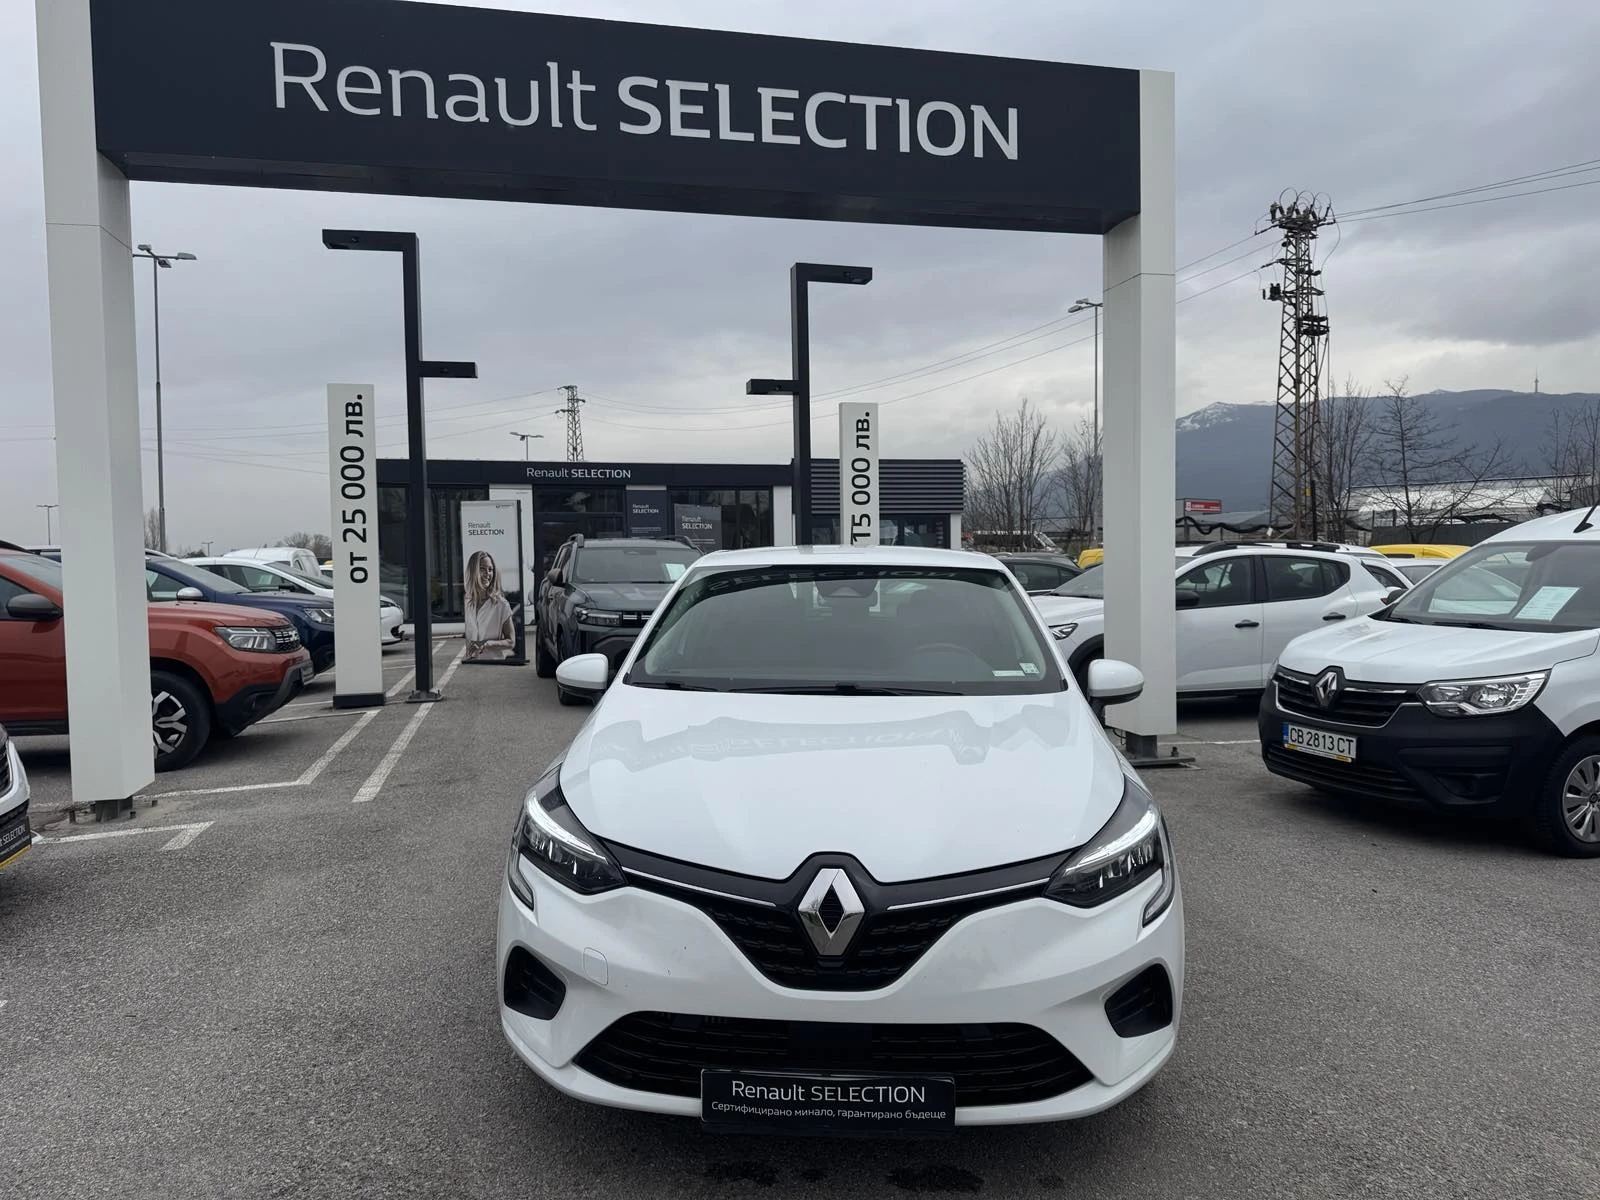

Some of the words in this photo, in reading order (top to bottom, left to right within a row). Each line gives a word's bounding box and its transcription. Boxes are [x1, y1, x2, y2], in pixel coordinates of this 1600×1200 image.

[269, 41, 597, 132] Renault
[617, 75, 1019, 161] SELECTION
[345, 394, 364, 438] лв.
[856, 411, 870, 450] лв.
[340, 445, 366, 500] 000
[526, 467, 569, 478] Renault
[571, 468, 631, 479] SELECTION
[851, 457, 871, 506] 000
[342, 508, 367, 543] 25
[468, 528, 505, 536] SELECTION
[349, 551, 369, 584] от
[732, 1081, 805, 1101] Renault
[811, 1085, 925, 1103] SELECTION
[711, 1101, 793, 1116] Сертифицирано
[794, 1107, 836, 1117] минало,
[837, 1109, 903, 1119] гарантирано
[905, 1109, 947, 1120] бъдеще
